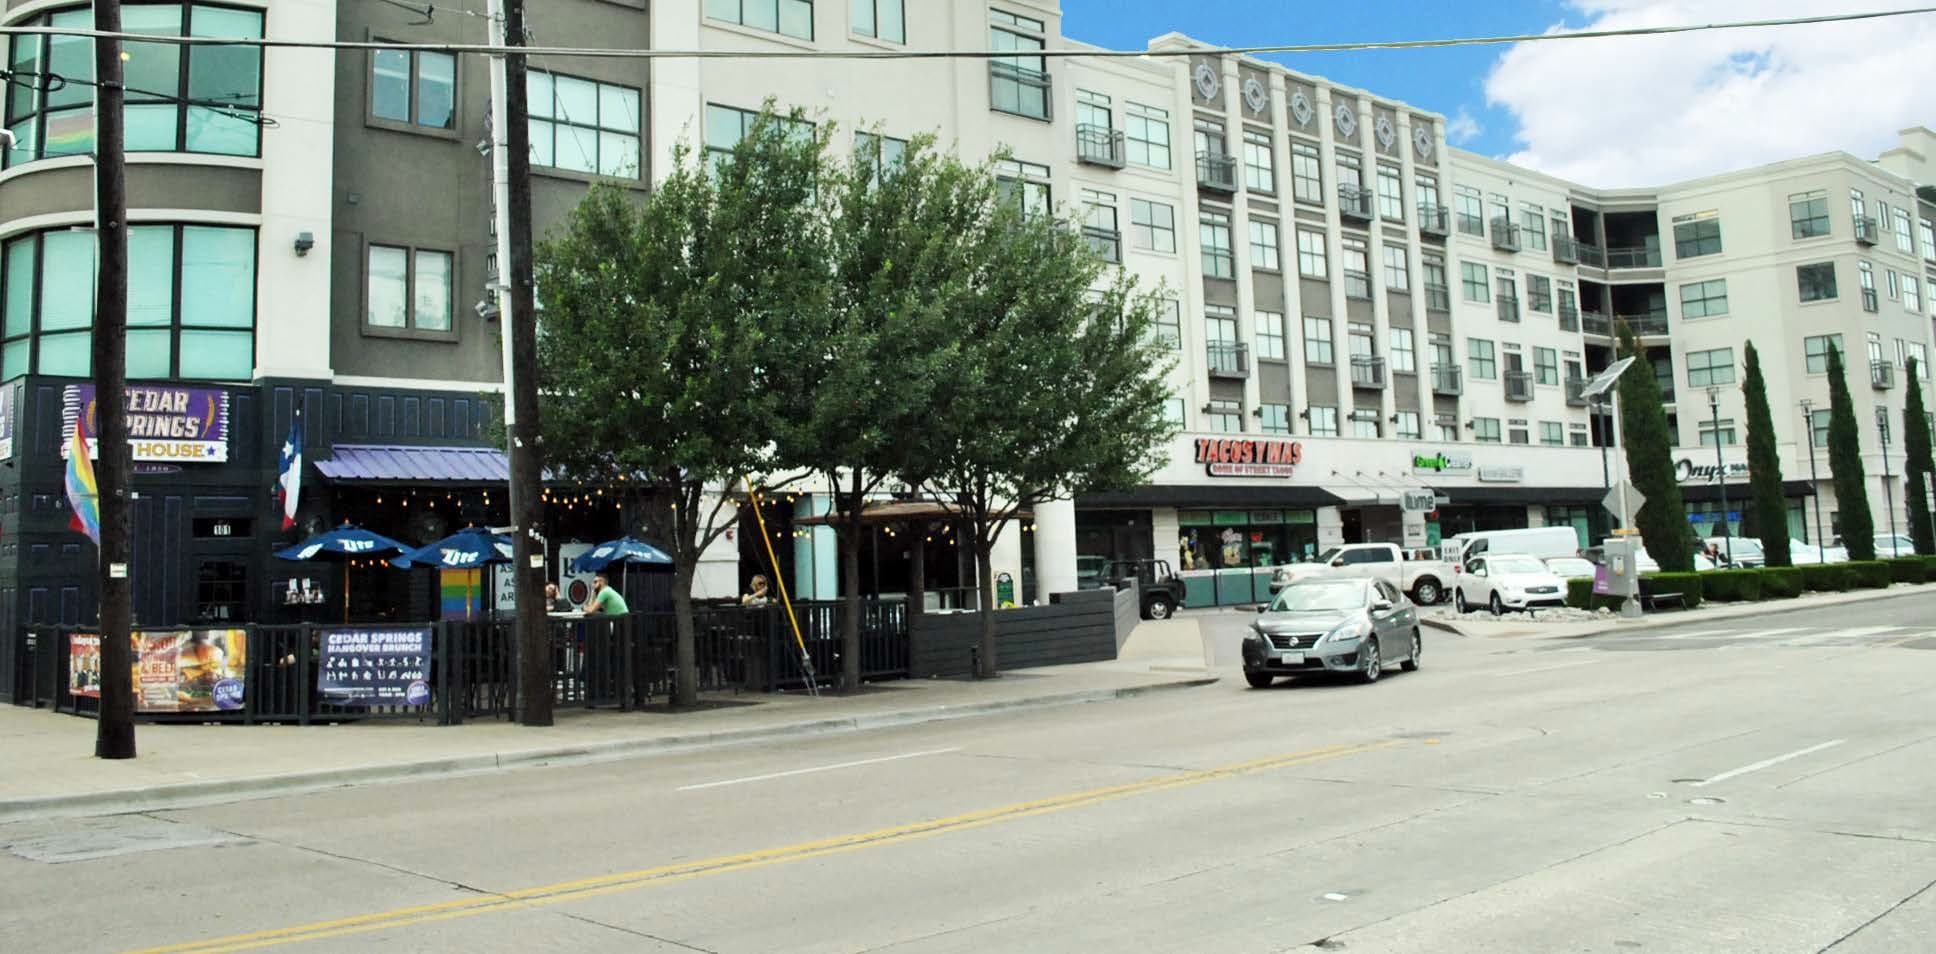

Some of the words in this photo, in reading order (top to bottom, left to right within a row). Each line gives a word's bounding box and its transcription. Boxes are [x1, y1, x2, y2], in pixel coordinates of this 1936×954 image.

[137, 443, 205, 457] HOUSE
[1674, 458, 1726, 482] Onyx
[440, 548, 479, 565] Lite
[328, 634, 368, 645] CEDAR
[370, 632, 422, 644] SPRINGS
[328, 644, 380, 653] HANGOVER
[382, 644, 422, 653] BRUNCH
